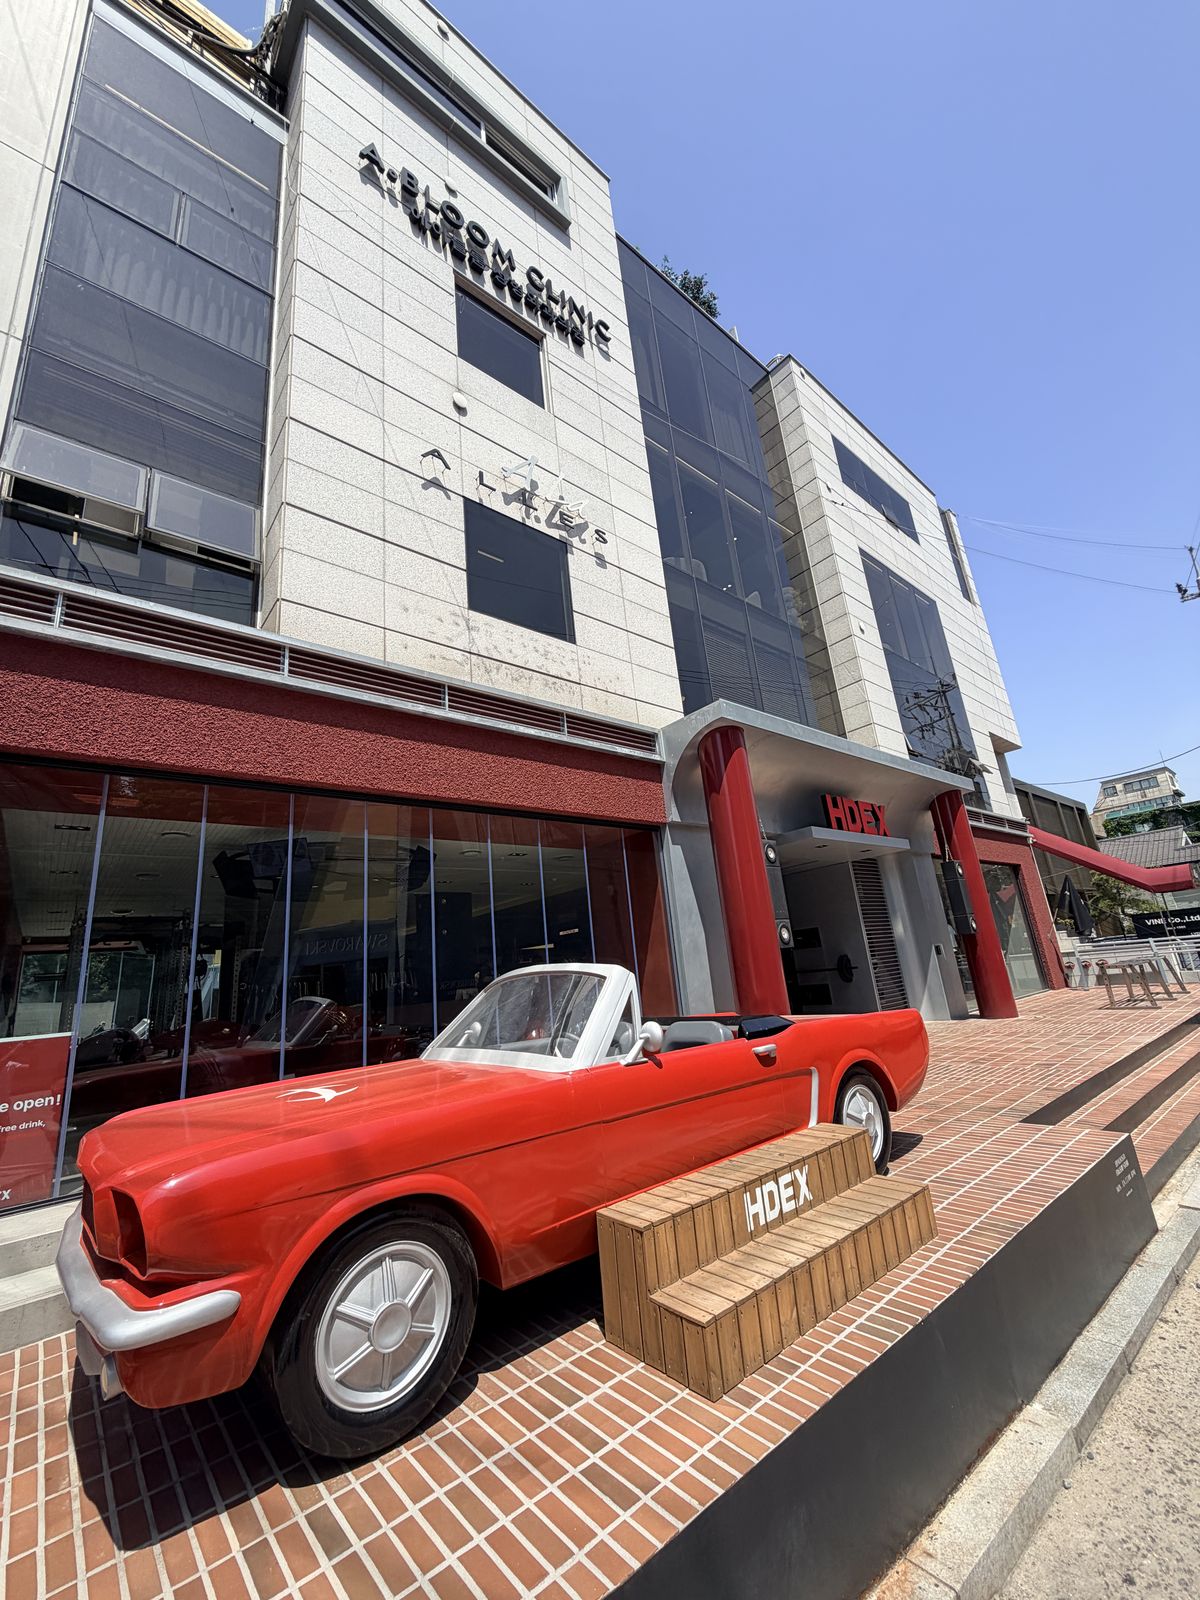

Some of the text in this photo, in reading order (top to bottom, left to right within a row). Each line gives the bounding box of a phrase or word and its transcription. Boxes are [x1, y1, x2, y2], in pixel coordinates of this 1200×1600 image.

[526, 265, 611, 343] CLINIC
[821, 792, 891, 837] HDEX
[13, 1094, 61, 1112] open!
[743, 1164, 813, 1233] HDEX
